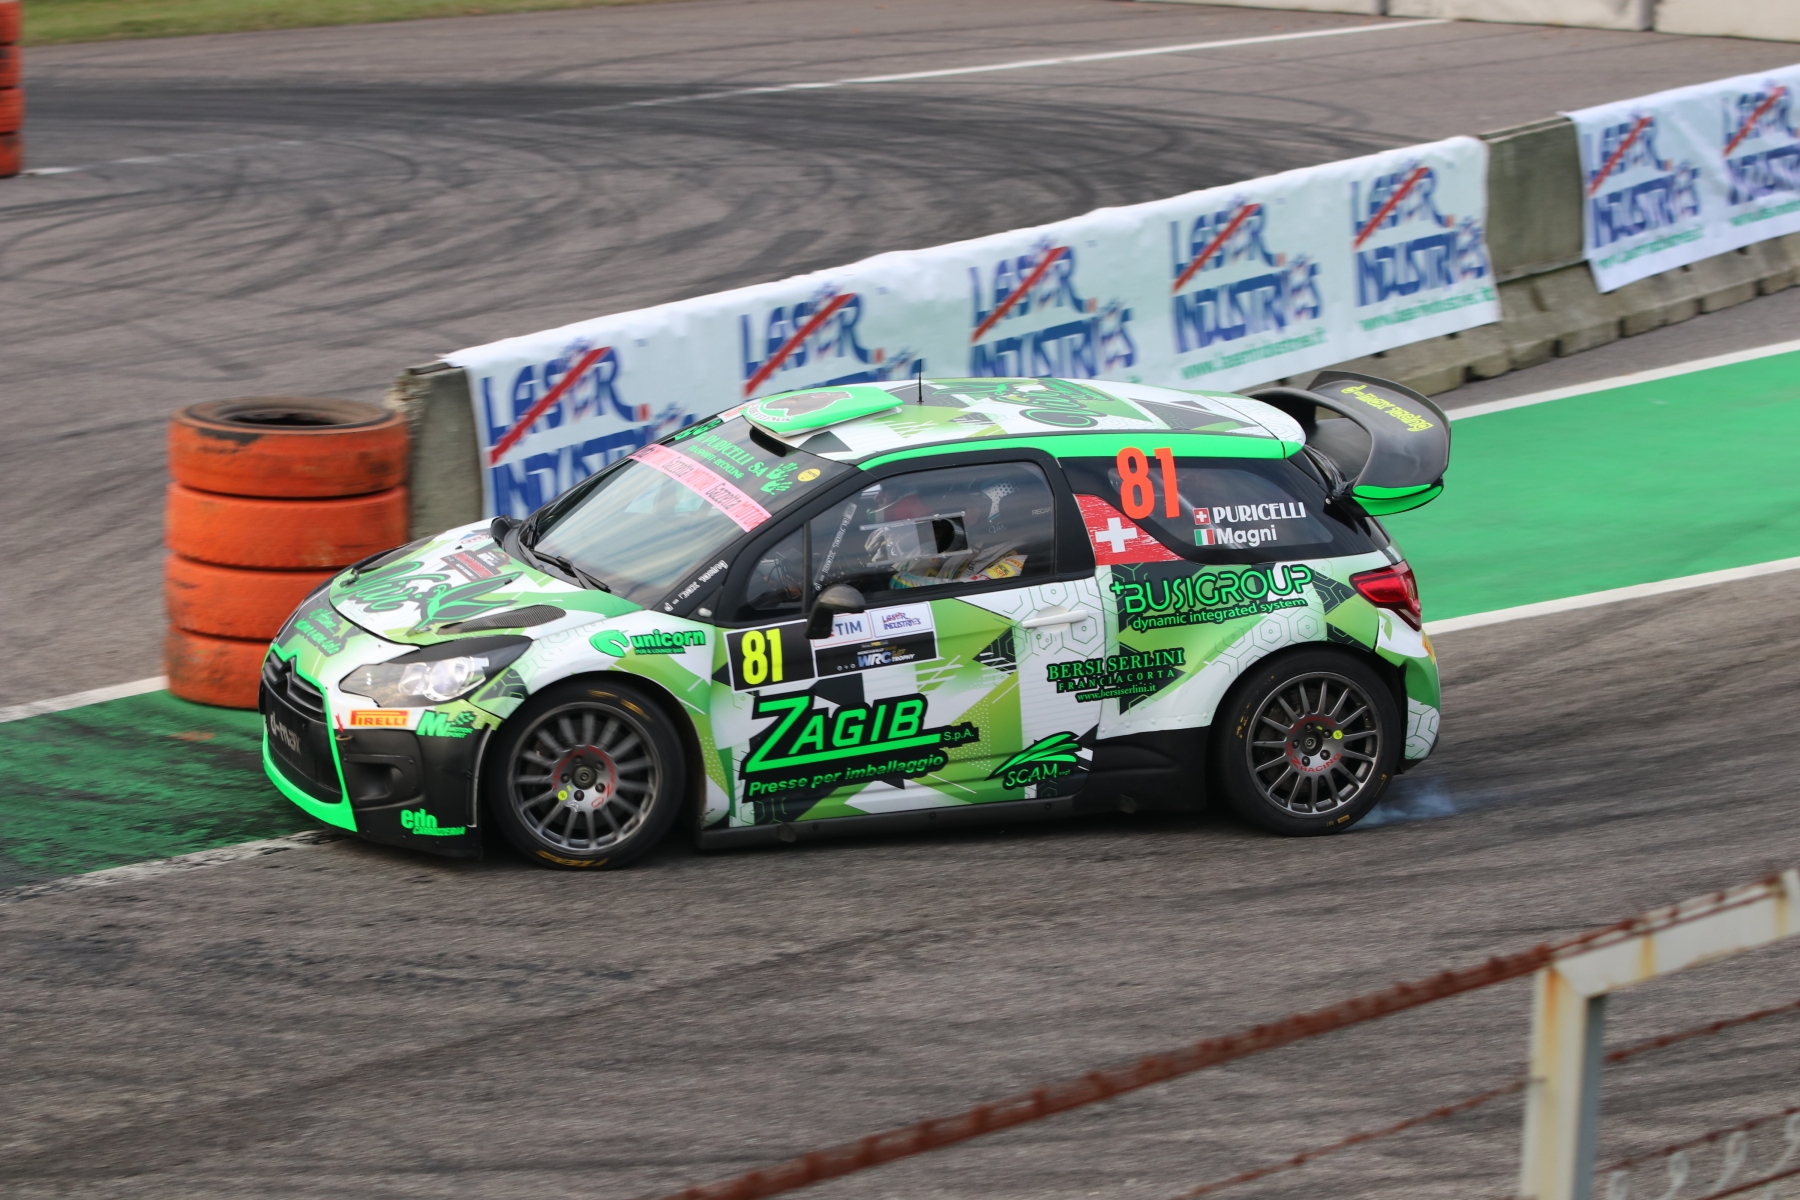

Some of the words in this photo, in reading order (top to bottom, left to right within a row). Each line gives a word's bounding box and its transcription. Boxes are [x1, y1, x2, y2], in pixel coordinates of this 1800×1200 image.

[1350, 167, 1454, 240] LASER
[1170, 204, 1286, 283] LASER
[970, 247, 1098, 334] LASER
[740, 292, 884, 385] LASER
[482, 346, 648, 455] LASER
[1116, 446, 1180, 520] 81
[1212, 502, 1307, 523] PURICELLI
[1216, 524, 1278, 547] Magni
[835, 620, 862, 636] TIM
[1132, 612, 1187, 632] dynamic
[1190, 603, 1258, 623] integrated
[1260, 598, 1306, 614] system
[631, 629, 706, 649] unicorn
[741, 628, 783, 686] 81
[857, 651, 892, 668] WRC
[1048, 659, 1102, 680] BERSI
[1107, 650, 1184, 672] SERLINI
[1058, 669, 1175, 691] FRANCIACORTA
[1077, 682, 1156, 701] www.bersiserlini.it
[350, 710, 408, 726] PIRELLI
[746, 696, 924, 772] ZAGIB
[943, 729, 975, 742] S.p.A.
[749, 775, 808, 797] Presse
[811, 771, 841, 789] per
[844, 753, 944, 780] imballaggio
[1005, 763, 1058, 787] SCAM
[1300, 752, 1342, 773] RACING
